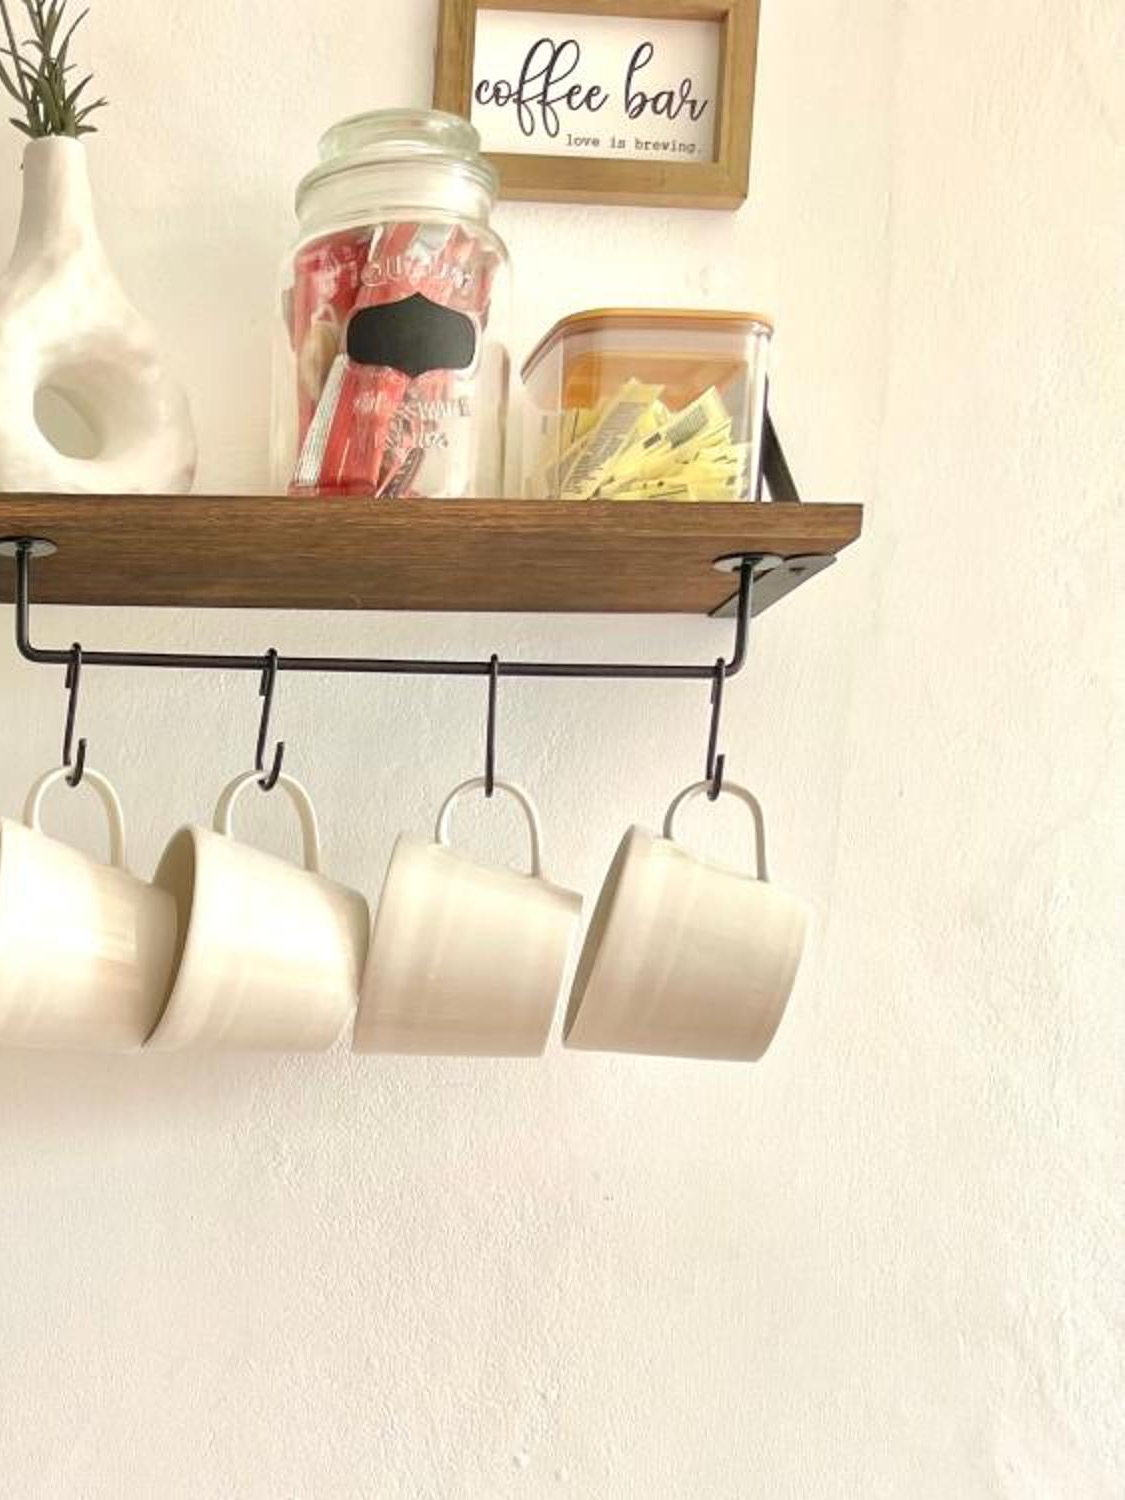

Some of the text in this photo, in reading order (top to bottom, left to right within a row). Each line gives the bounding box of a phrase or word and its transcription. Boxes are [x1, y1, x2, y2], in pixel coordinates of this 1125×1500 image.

[475, 38, 708, 138] coffee bar
[566, 134, 600, 148] love
[610, 136, 626, 149] is
